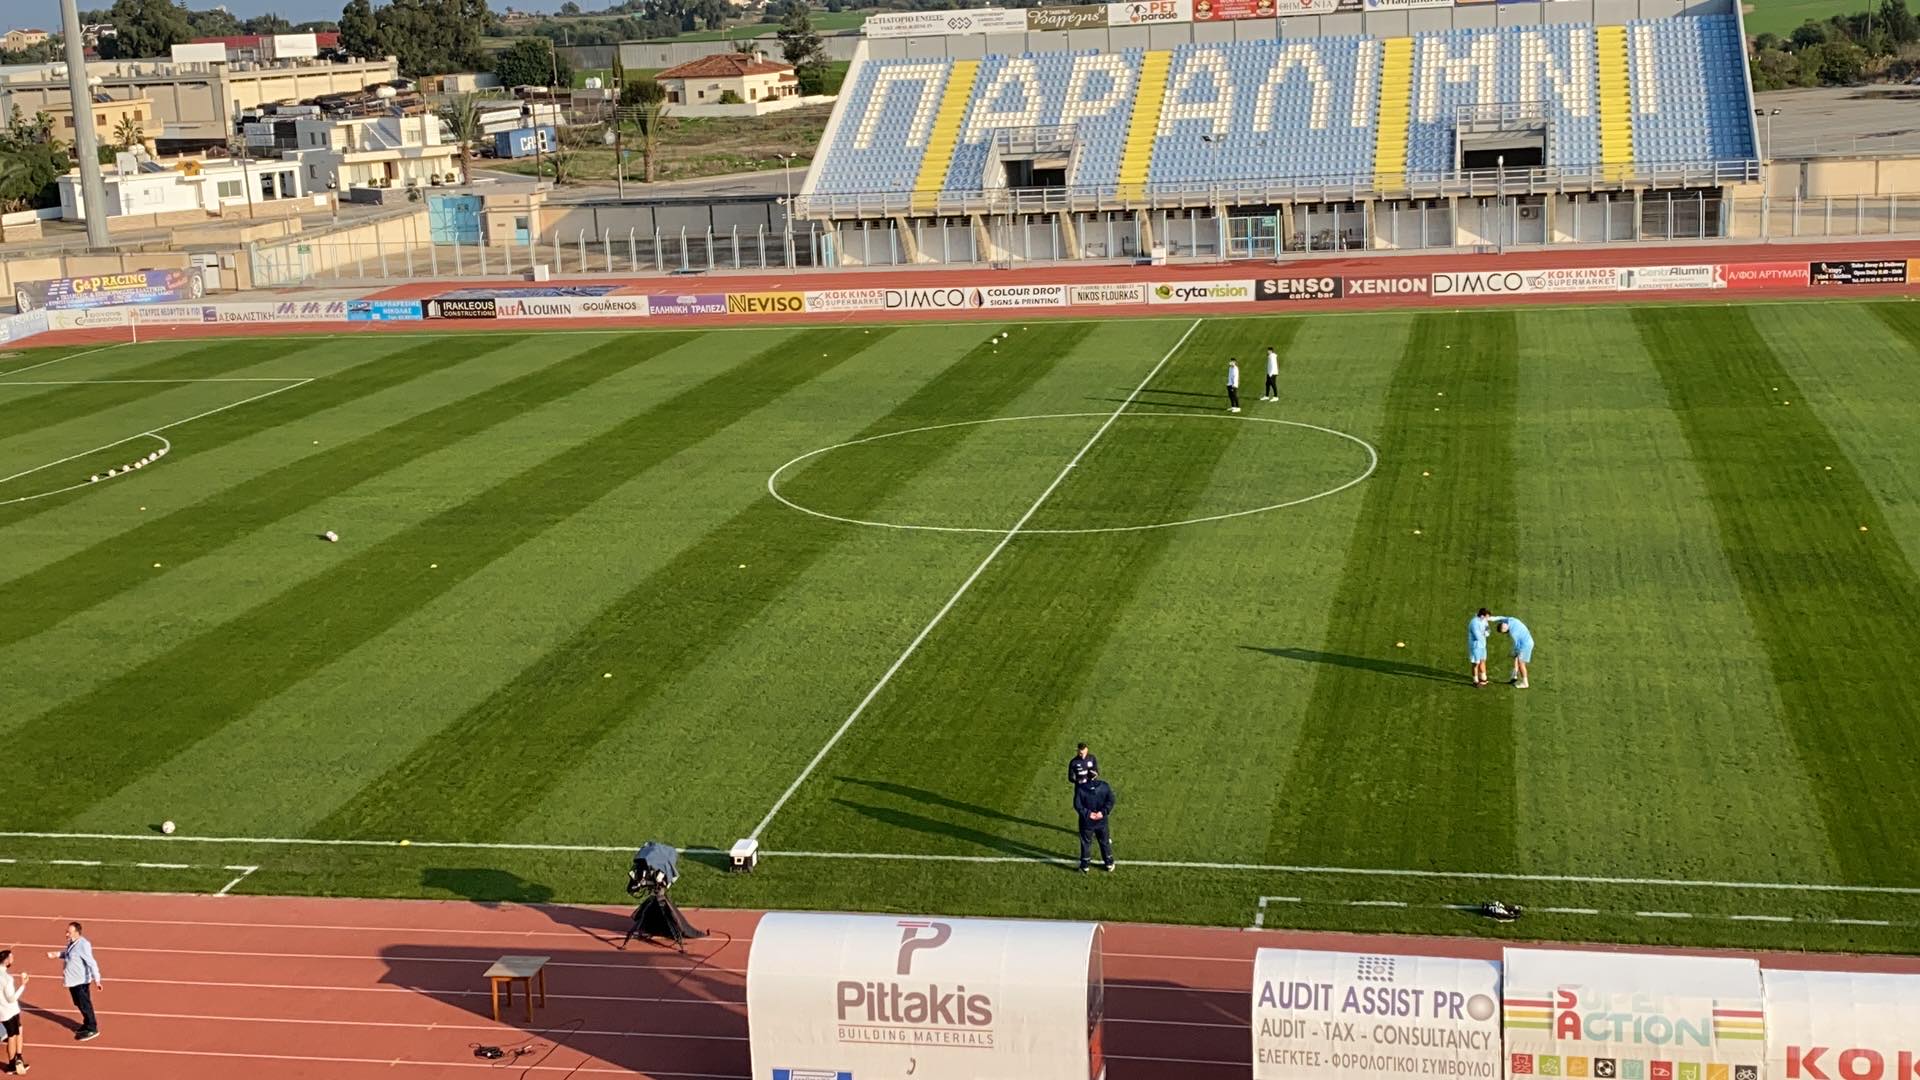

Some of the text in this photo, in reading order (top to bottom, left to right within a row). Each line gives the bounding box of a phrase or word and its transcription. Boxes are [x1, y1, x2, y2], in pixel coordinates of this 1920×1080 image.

[1150, 1, 1176, 13] PET
[1141, 11, 1178, 22] parade
[1548, 269, 1616, 279] KOKKINOS
[1548, 278, 1616, 286] SUPERMARKET
[72, 277, 100, 293] G&P
[102, 274, 148, 286] RACING
[1264, 278, 1334, 294] SENSO
[1349, 278, 1427, 294] XENION
[1434, 273, 1522, 293] DIMCO
[825, 290, 883, 298] KOKKINOS
[886, 288, 964, 308] DIMCO
[988, 287, 1062, 296] COLOUR DROP
[1078, 292, 1100, 300] NIKOS
[1176, 284, 1248, 301] cytavision
[443, 301, 494, 310] IRAKLEOUS
[582, 302, 637, 310] GOUMENOS
[650, 304, 726, 314] ΕΛΛΗΝΙΚΗ ΤΡΑΠΕΖΑ
[729, 294, 802, 312] NEVISO
[836, 980, 992, 1026] Pittakis
[1258, 981, 1333, 1011] AUDIT
[1341, 986, 1424, 1017] ASSIST
[1260, 1018, 1306, 1039] AUDIT
[1323, 1021, 1355, 1042] TAX
[1373, 1024, 1492, 1050] CONSULTANCY
[1557, 1010, 1712, 1047] ACTION
[838, 1028, 994, 1046] BUILDING MATERIALS
[1258, 1048, 1495, 1078] ΕΛΕΓΚΤΕΣ ΦΟΡΟΛΟΓΙΚΟΙ ΣΥΜΒΟΥΛΟΙ
